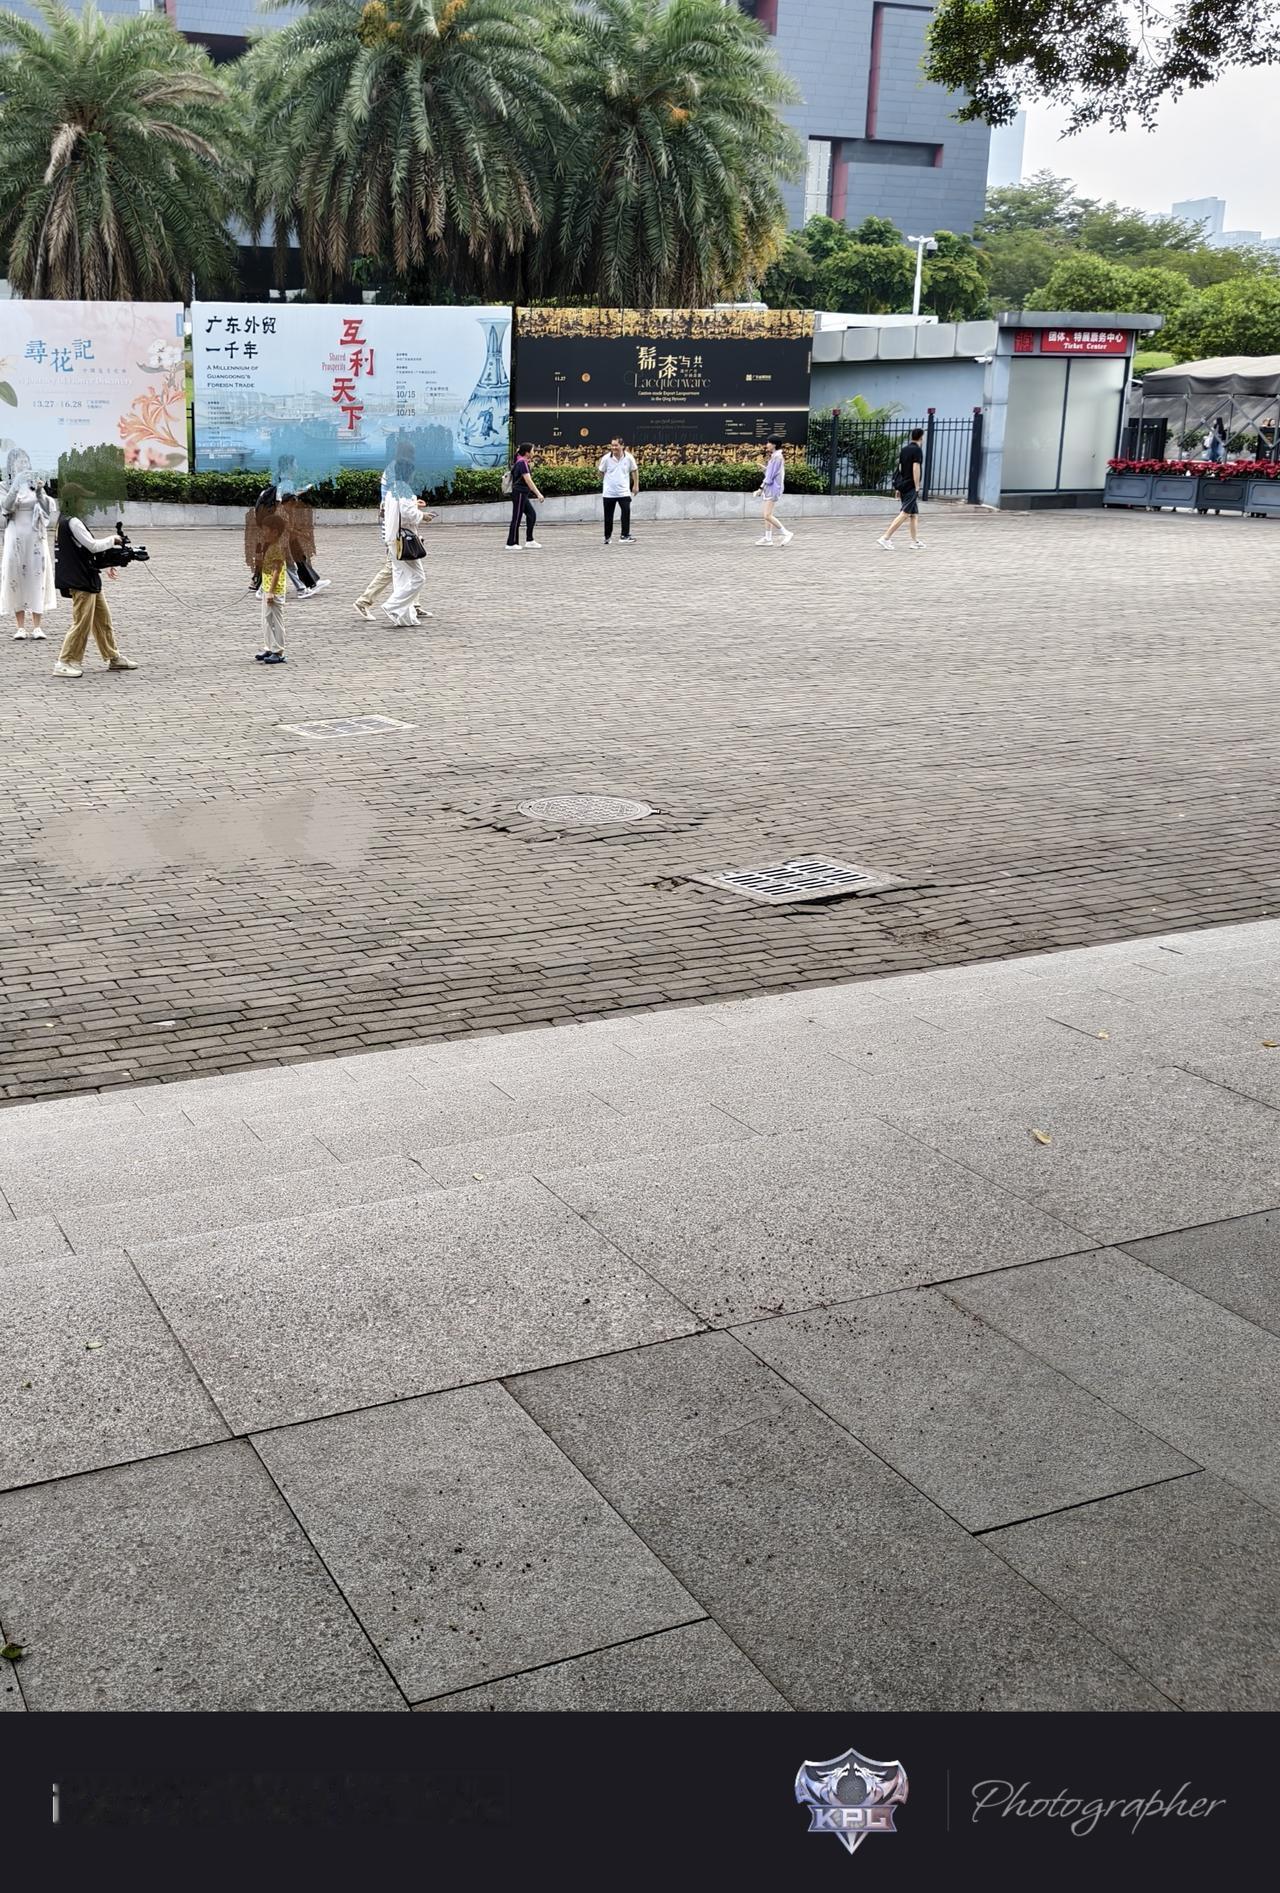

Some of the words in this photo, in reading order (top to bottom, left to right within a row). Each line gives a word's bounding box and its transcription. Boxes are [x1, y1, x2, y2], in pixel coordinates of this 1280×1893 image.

[205, 315, 277, 334] 广东外贸
[24, 338, 95, 373] 尋花記
[205, 340, 259, 359] 一千年
[331, 318, 374, 430] 互利天下
[634, 373, 711, 390] Lacquerware
[396, 408, 416, 416] 10/15
